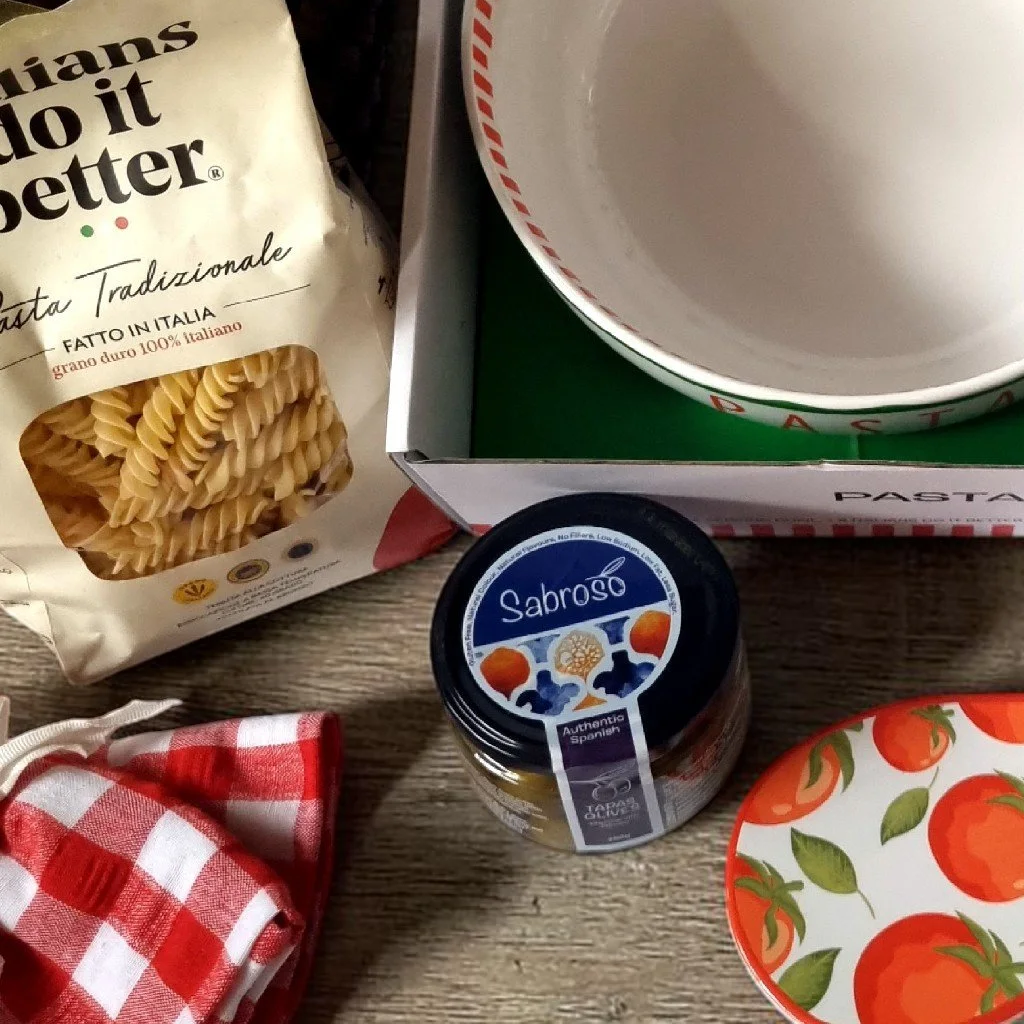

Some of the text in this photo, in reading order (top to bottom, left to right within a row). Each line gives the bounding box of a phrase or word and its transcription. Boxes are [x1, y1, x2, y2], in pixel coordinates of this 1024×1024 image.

[0, 21, 199, 100] lians
[94, 70, 162, 136] it
[0, 231, 292, 335] asta Tradizionale
[51, 320, 243, 380] grano duro 100% italiano
[62, 306, 216, 353] FATTO IN ITALIA
[500, 574, 626, 624] Sabroso
[562, 714, 625, 736] Authentic
[569, 725, 621, 745] Spanish
